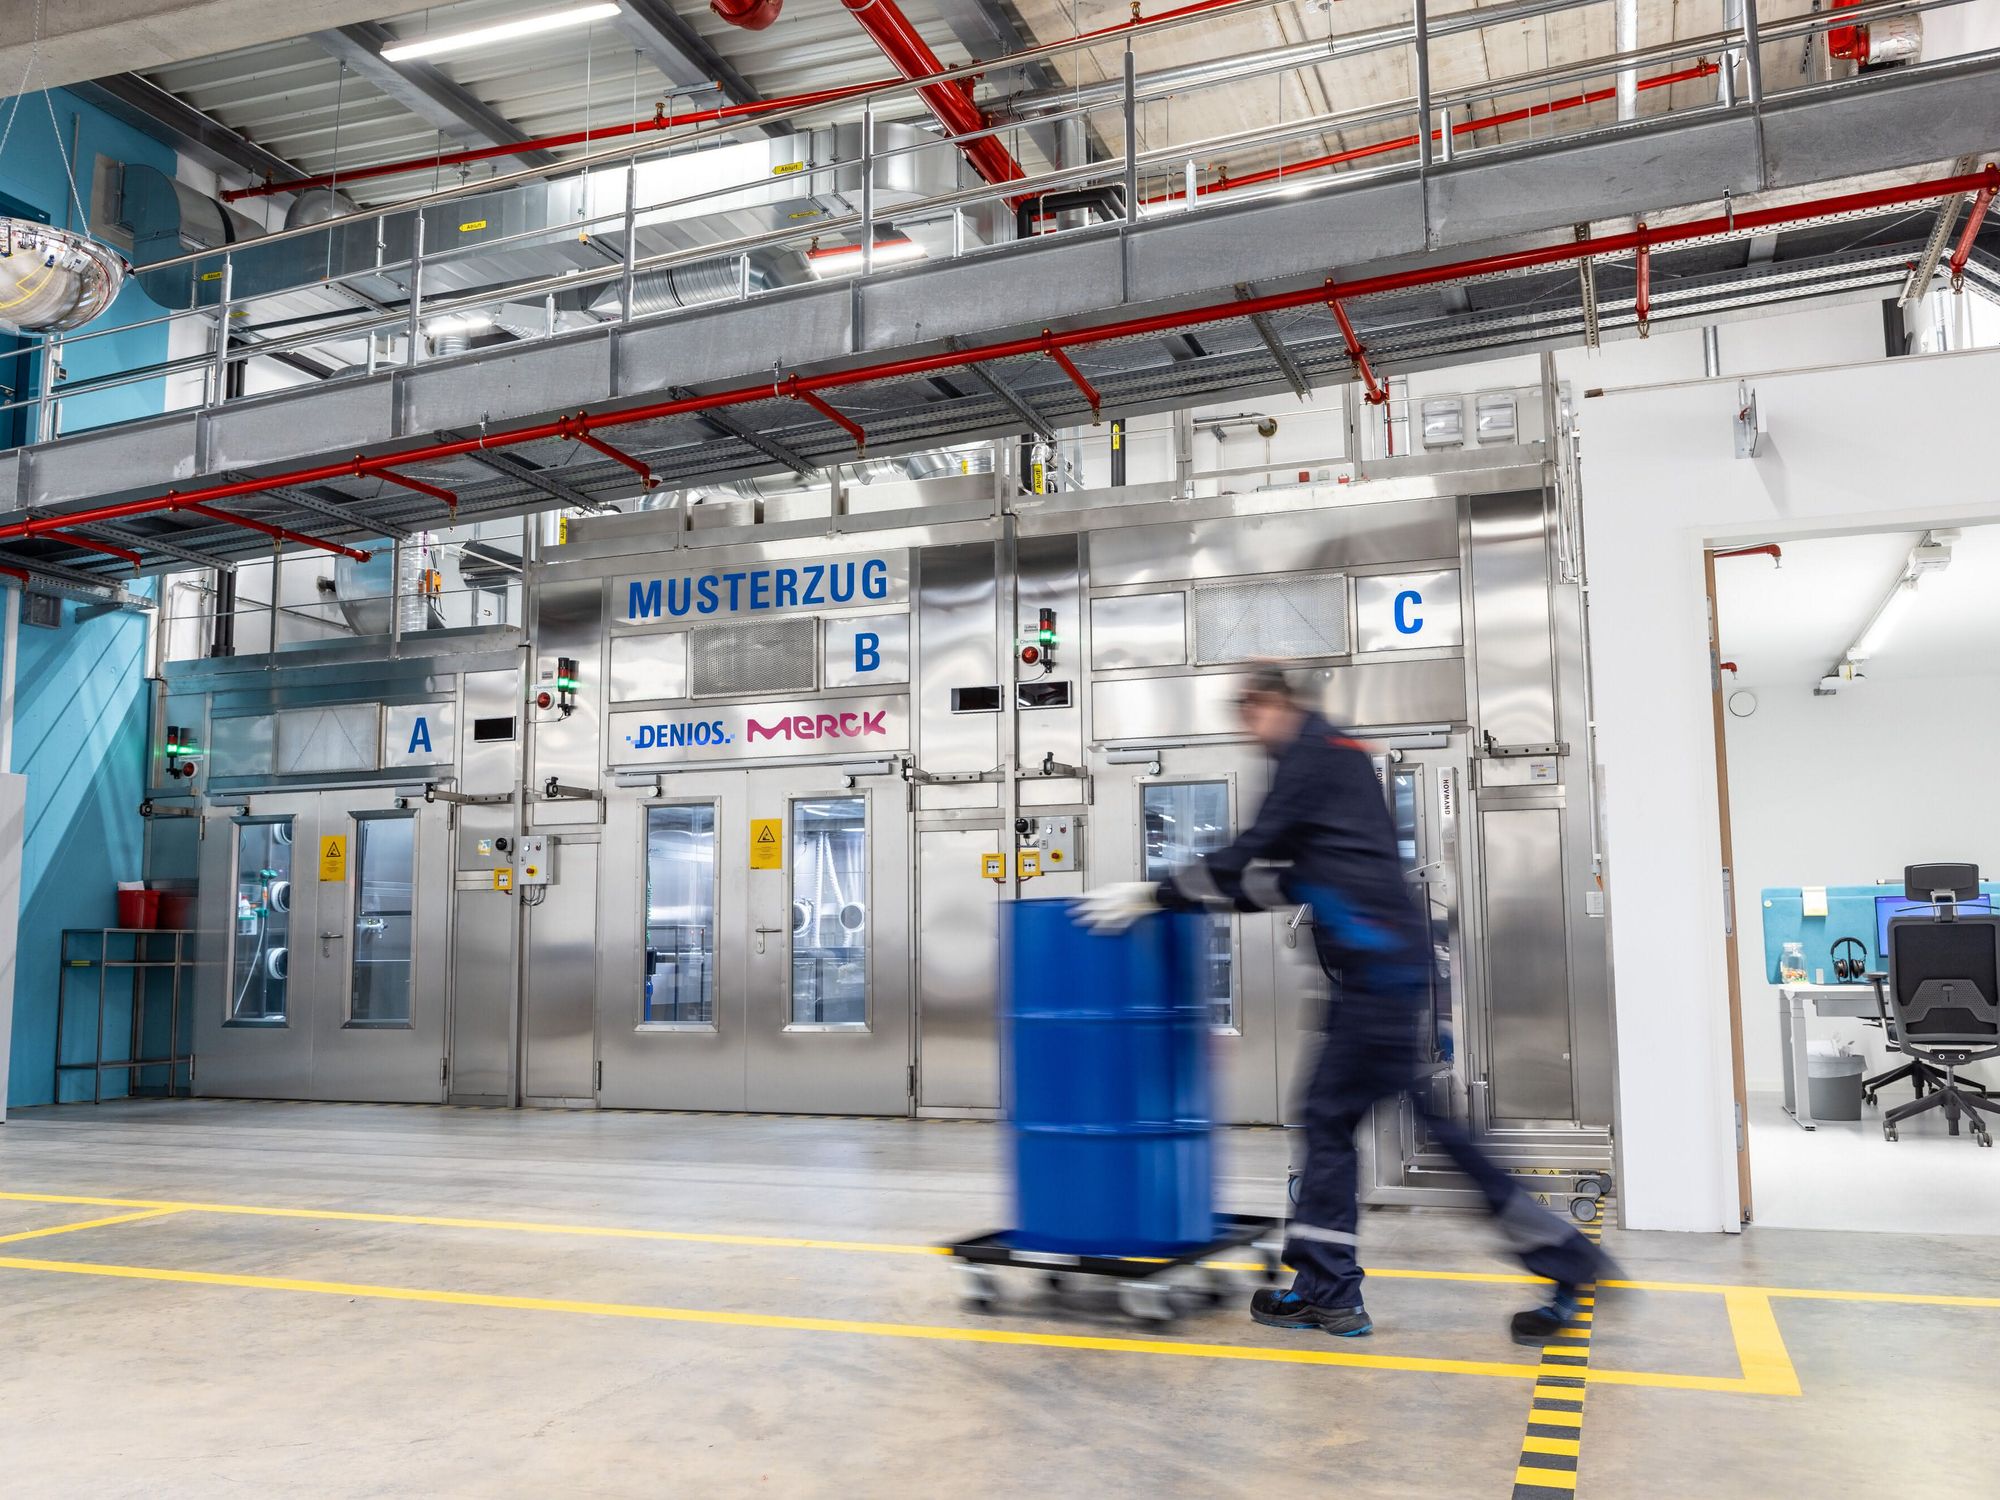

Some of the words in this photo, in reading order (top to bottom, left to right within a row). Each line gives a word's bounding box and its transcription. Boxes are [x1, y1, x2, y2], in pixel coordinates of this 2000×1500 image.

[628, 559, 888, 620] MUSTERZUG
[1394, 590, 1424, 635] C
[854, 632, 881, 673] B
[407, 717, 433, 754] A
[1442, 779, 1451, 815] HOVMAND
